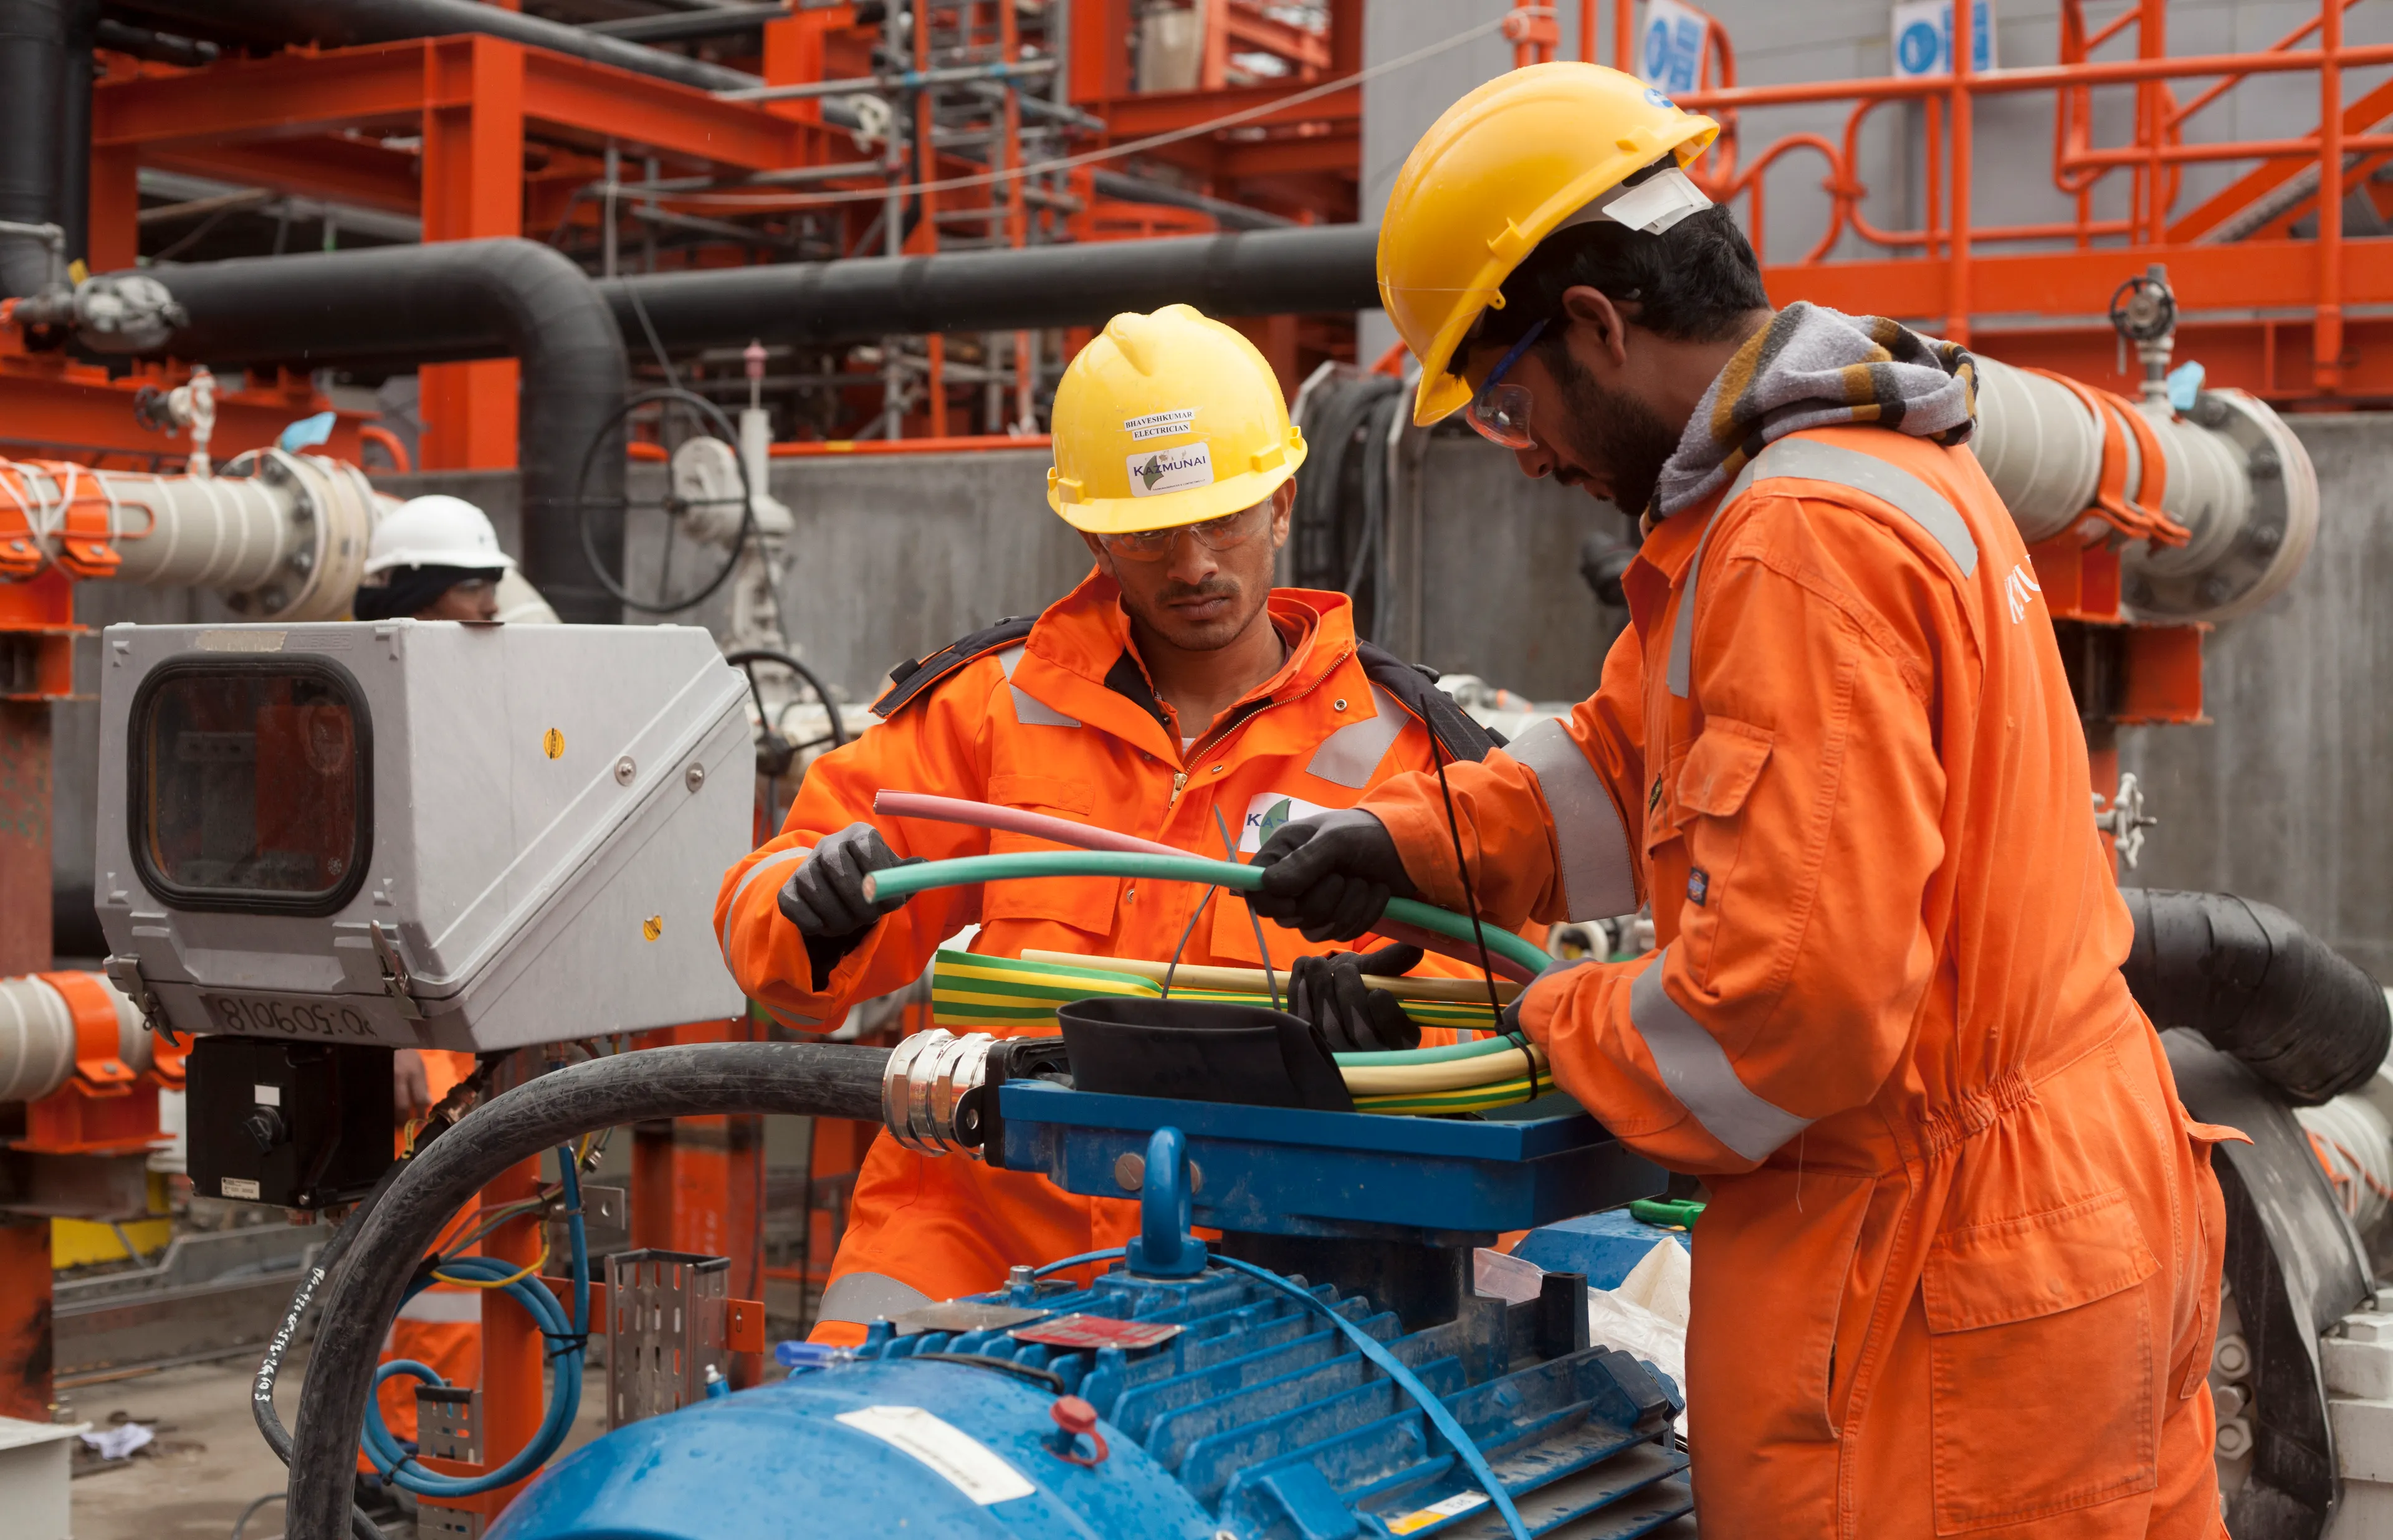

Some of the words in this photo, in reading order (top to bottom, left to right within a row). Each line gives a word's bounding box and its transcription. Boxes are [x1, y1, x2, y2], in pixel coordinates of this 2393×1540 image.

[1125, 412, 1192, 428] BHAVESHKUMAR
[1134, 424, 1189, 438] ELECTRICIAN
[1134, 456, 1206, 476] KAZMUNAI
